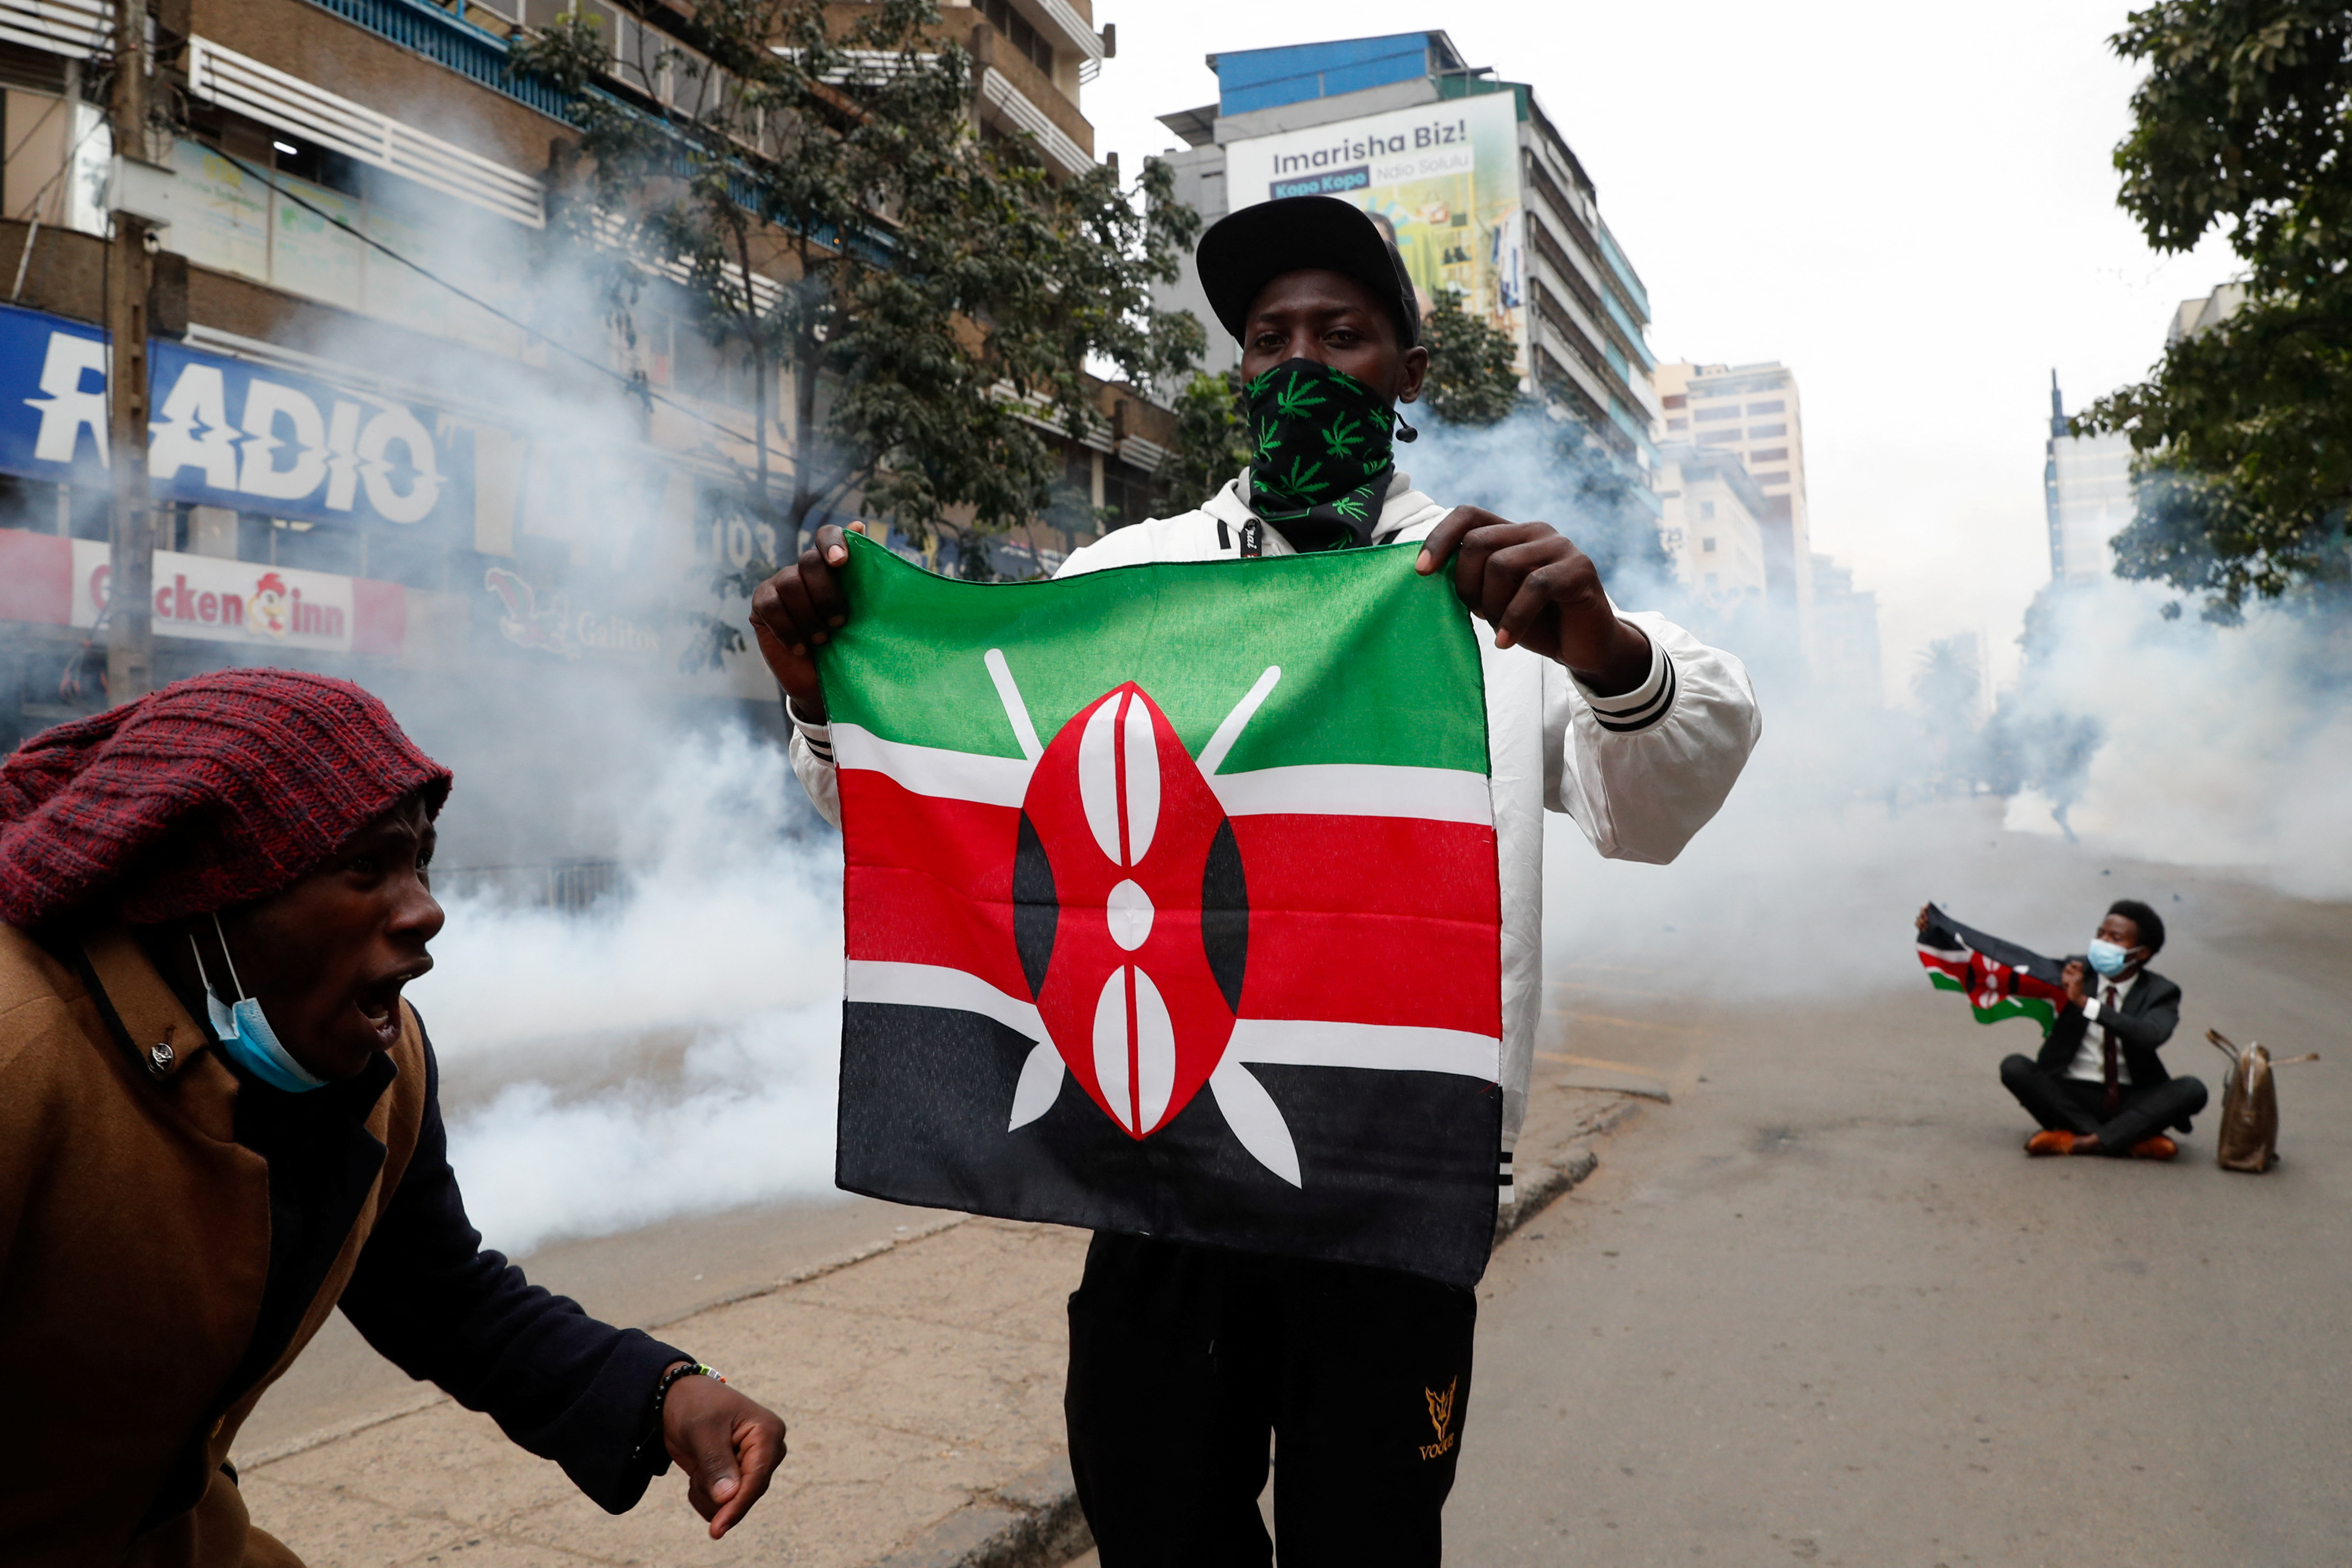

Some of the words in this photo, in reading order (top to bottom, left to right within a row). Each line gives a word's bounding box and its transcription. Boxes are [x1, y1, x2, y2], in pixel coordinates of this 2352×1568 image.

[1274, 134, 1405, 175] Imarisha
[1415, 119, 1466, 149] Biz!
[1321, 172, 1367, 191] Kopo
[23, 331, 448, 524] RADIO
[90, 564, 243, 625] Ccken
[292, 587, 345, 636] inn
